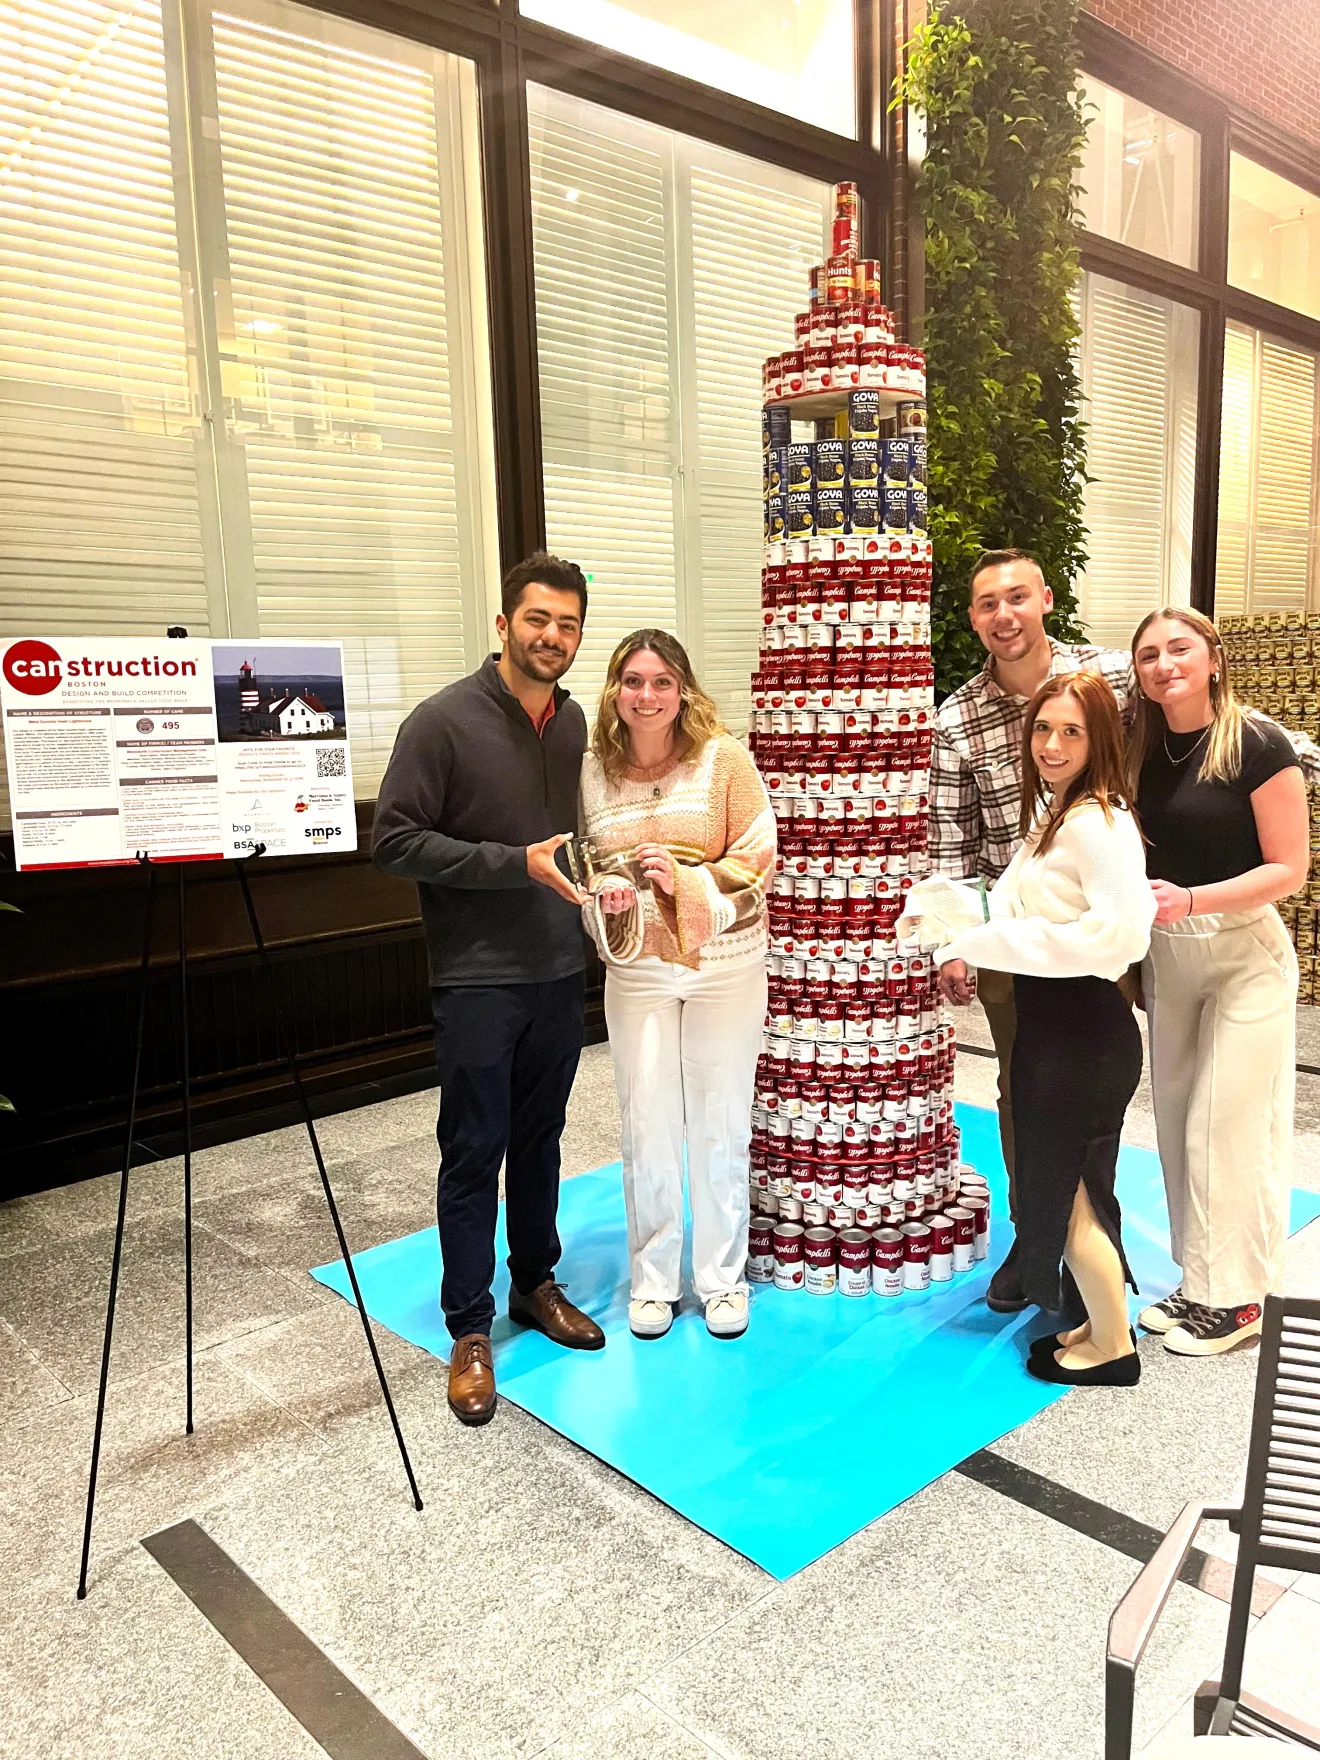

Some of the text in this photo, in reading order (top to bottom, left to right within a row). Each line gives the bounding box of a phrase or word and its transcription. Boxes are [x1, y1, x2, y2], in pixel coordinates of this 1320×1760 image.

[853, 392, 879, 402] GOYA
[816, 442, 843, 453] GOYA
[852, 441, 878, 451] GOYA
[817, 490, 843, 500] GOYA
[162, 721, 180, 730] 495
[232, 823, 252, 834] bxp
[304, 826, 342, 839] smps
